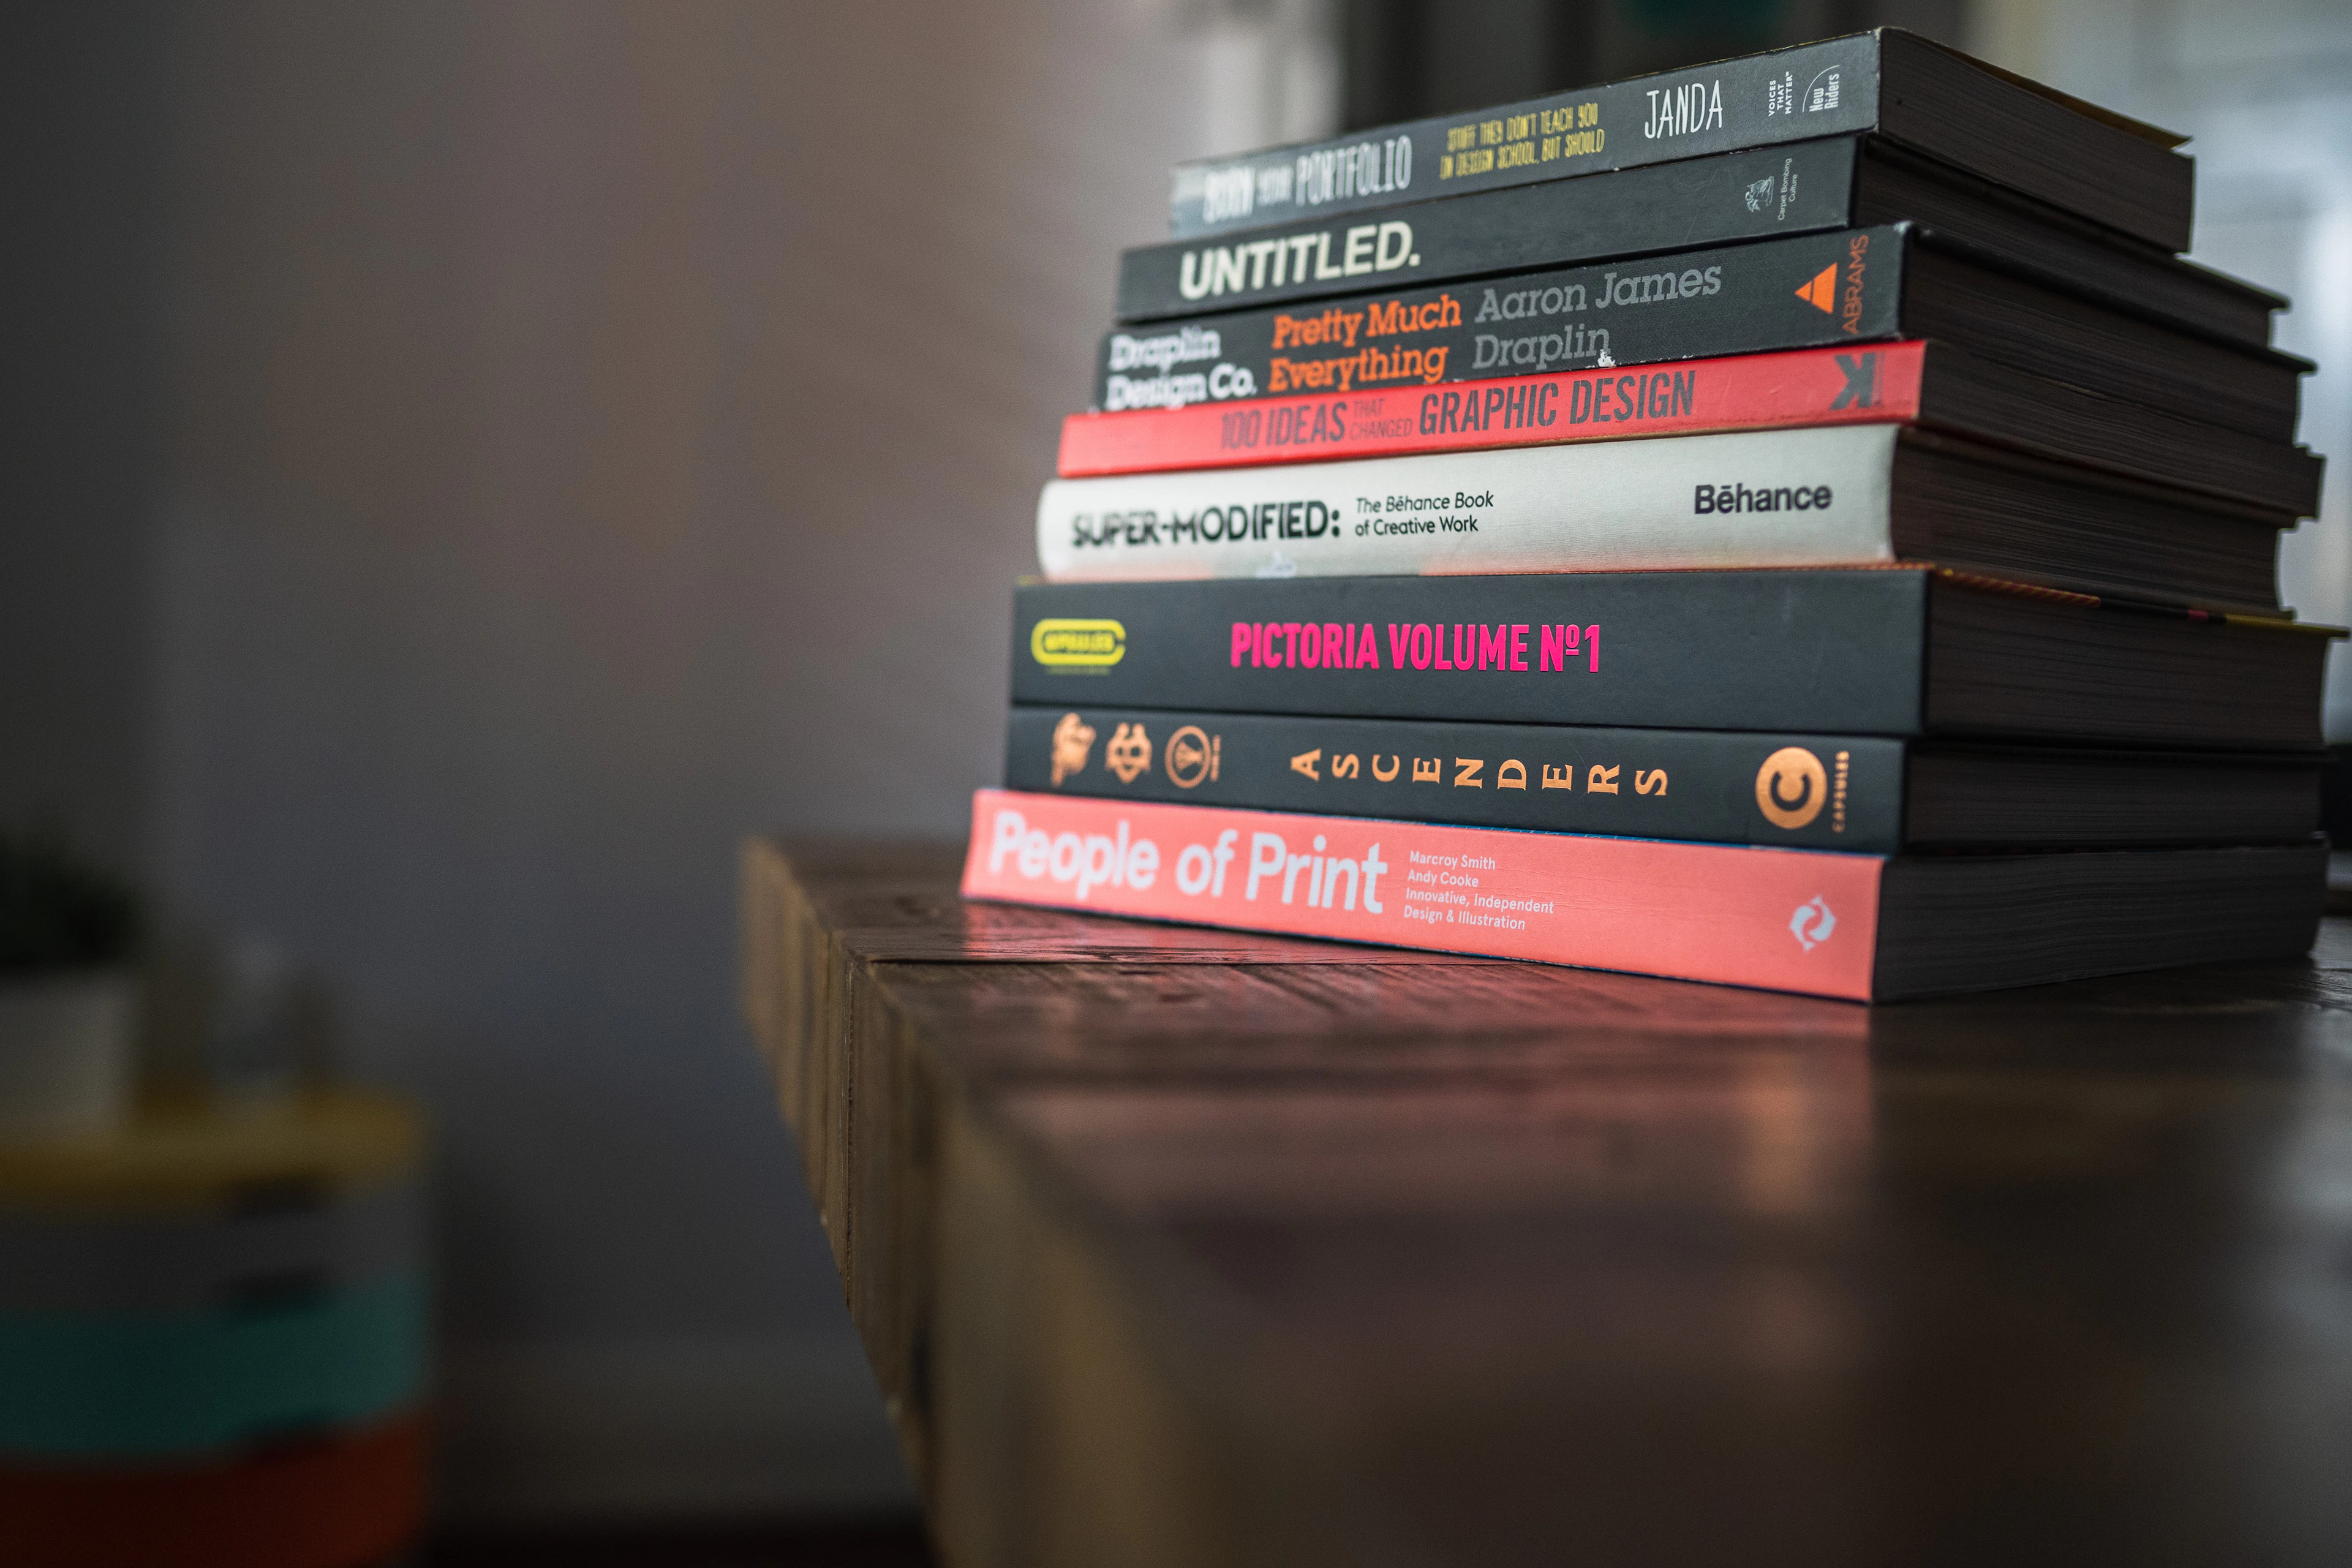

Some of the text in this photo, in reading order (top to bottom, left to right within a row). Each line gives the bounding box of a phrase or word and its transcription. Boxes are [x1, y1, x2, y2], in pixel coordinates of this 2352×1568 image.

[1645, 80, 1723, 139] JANDA
[1809, 88, 1825, 112] New
[1824, 74, 1840, 109] Riders
[1540, 107, 1574, 135] TEACH
[1578, 102, 1598, 128] YOU
[1295, 135, 1412, 207] PORTFOLIO
[1496, 141, 1540, 170] SCHOOL,
[1541, 135, 1561, 162] BUT
[1565, 129, 1605, 157] SHOULD
[1777, 158, 1793, 221] Carpet Bombing
[1788, 174, 1798, 202] Culture
[1179, 220, 1420, 301] UNTITLED.
[1474, 265, 1722, 324] Aaron James
[1842, 234, 1869, 335] ABRAMS
[1271, 294, 1462, 349] Pretty Much
[1108, 326, 1222, 374] Draplin
[1267, 345, 1449, 393] Everything
[1472, 324, 1610, 371] Draplin
[1208, 362, 1257, 400] Co.
[1419, 370, 1696, 436] GRAPHIC DESIGN
[1221, 402, 1348, 450] 100 IDEAS
[1350, 418, 1413, 441] CHANGED
[1353, 398, 1385, 418] THAT
[1072, 500, 1340, 548] SUPER-MODIFIED:
[1355, 514, 1479, 537] of Creative Work
[1356, 497, 1382, 514] The
[1455, 491, 1494, 509] Book
[1231, 622, 1379, 669] PICTORIA
[1388, 624, 1529, 672] VOLUME
[1291, 748, 1668, 796] ASCENDERS
[989, 810, 1387, 914] People of Print
[1408, 869, 1479, 888] Andy Cooke
[1409, 851, 1496, 870] Marcroy Smith
[1404, 905, 1526, 930] Design & Illustration
[1406, 887, 1555, 914] Innovative, Independent
